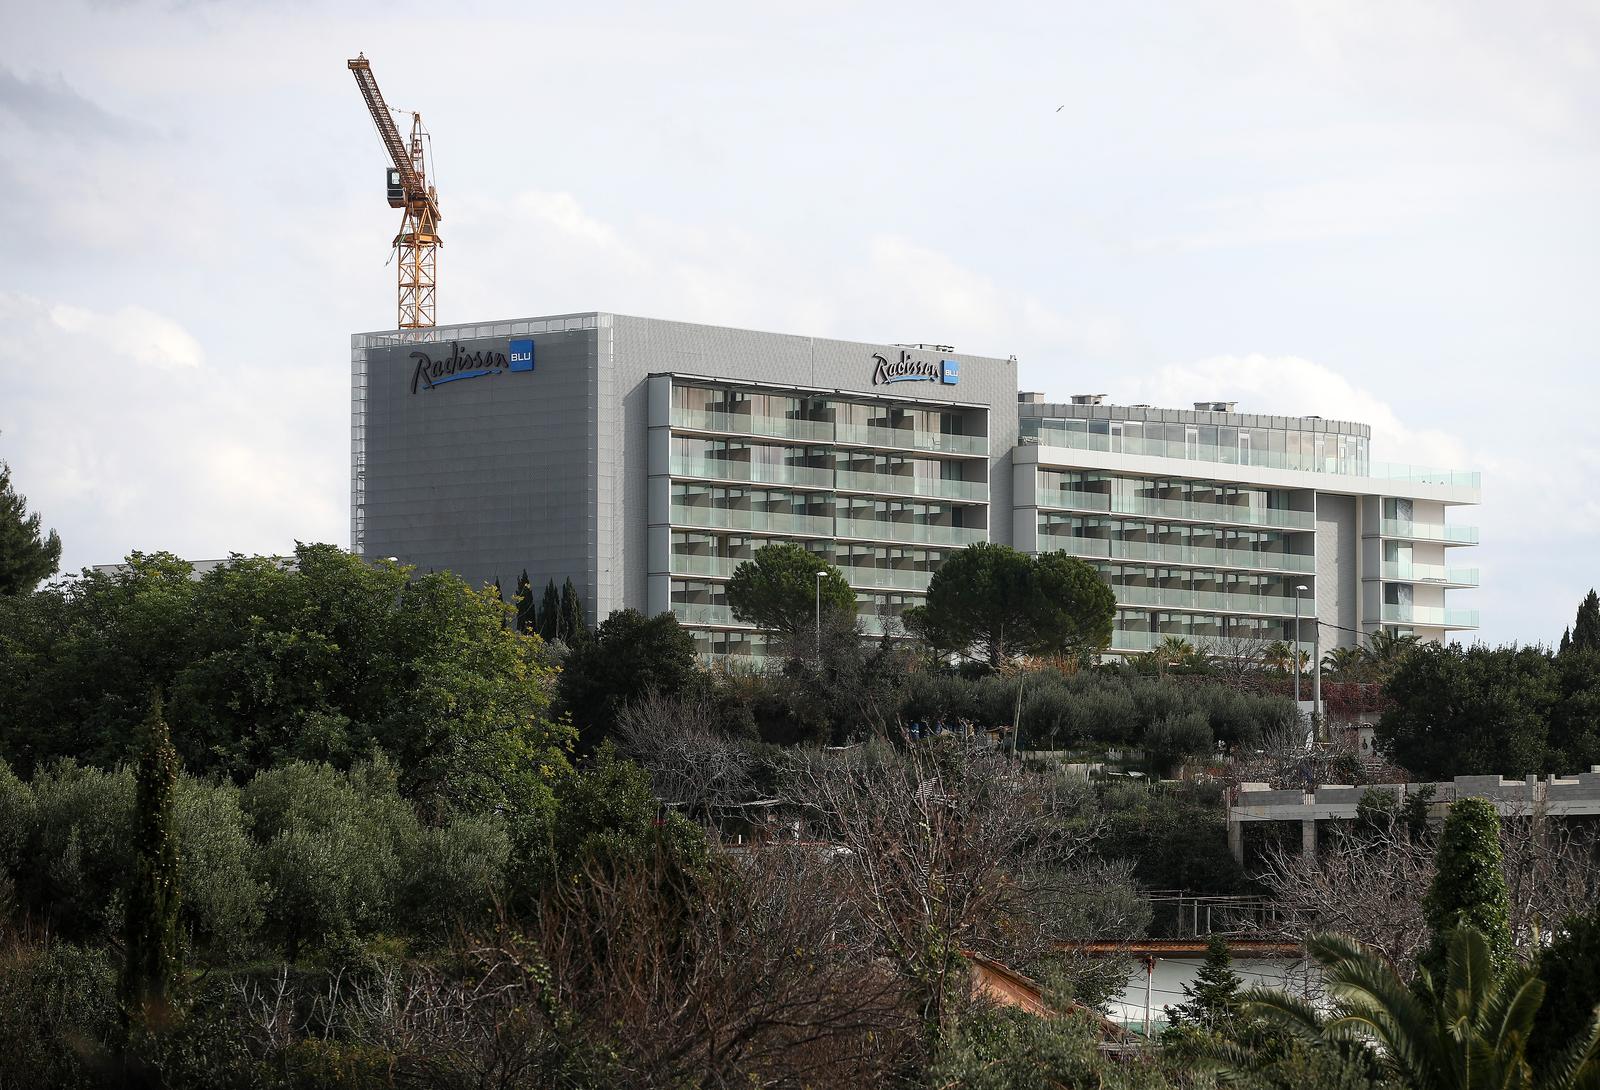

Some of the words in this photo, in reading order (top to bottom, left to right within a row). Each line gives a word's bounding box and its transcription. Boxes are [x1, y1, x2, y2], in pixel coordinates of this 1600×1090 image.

[409, 341, 509, 394] Radisson
[511, 352, 531, 361] BLU
[872, 351, 940, 386] Radisson
